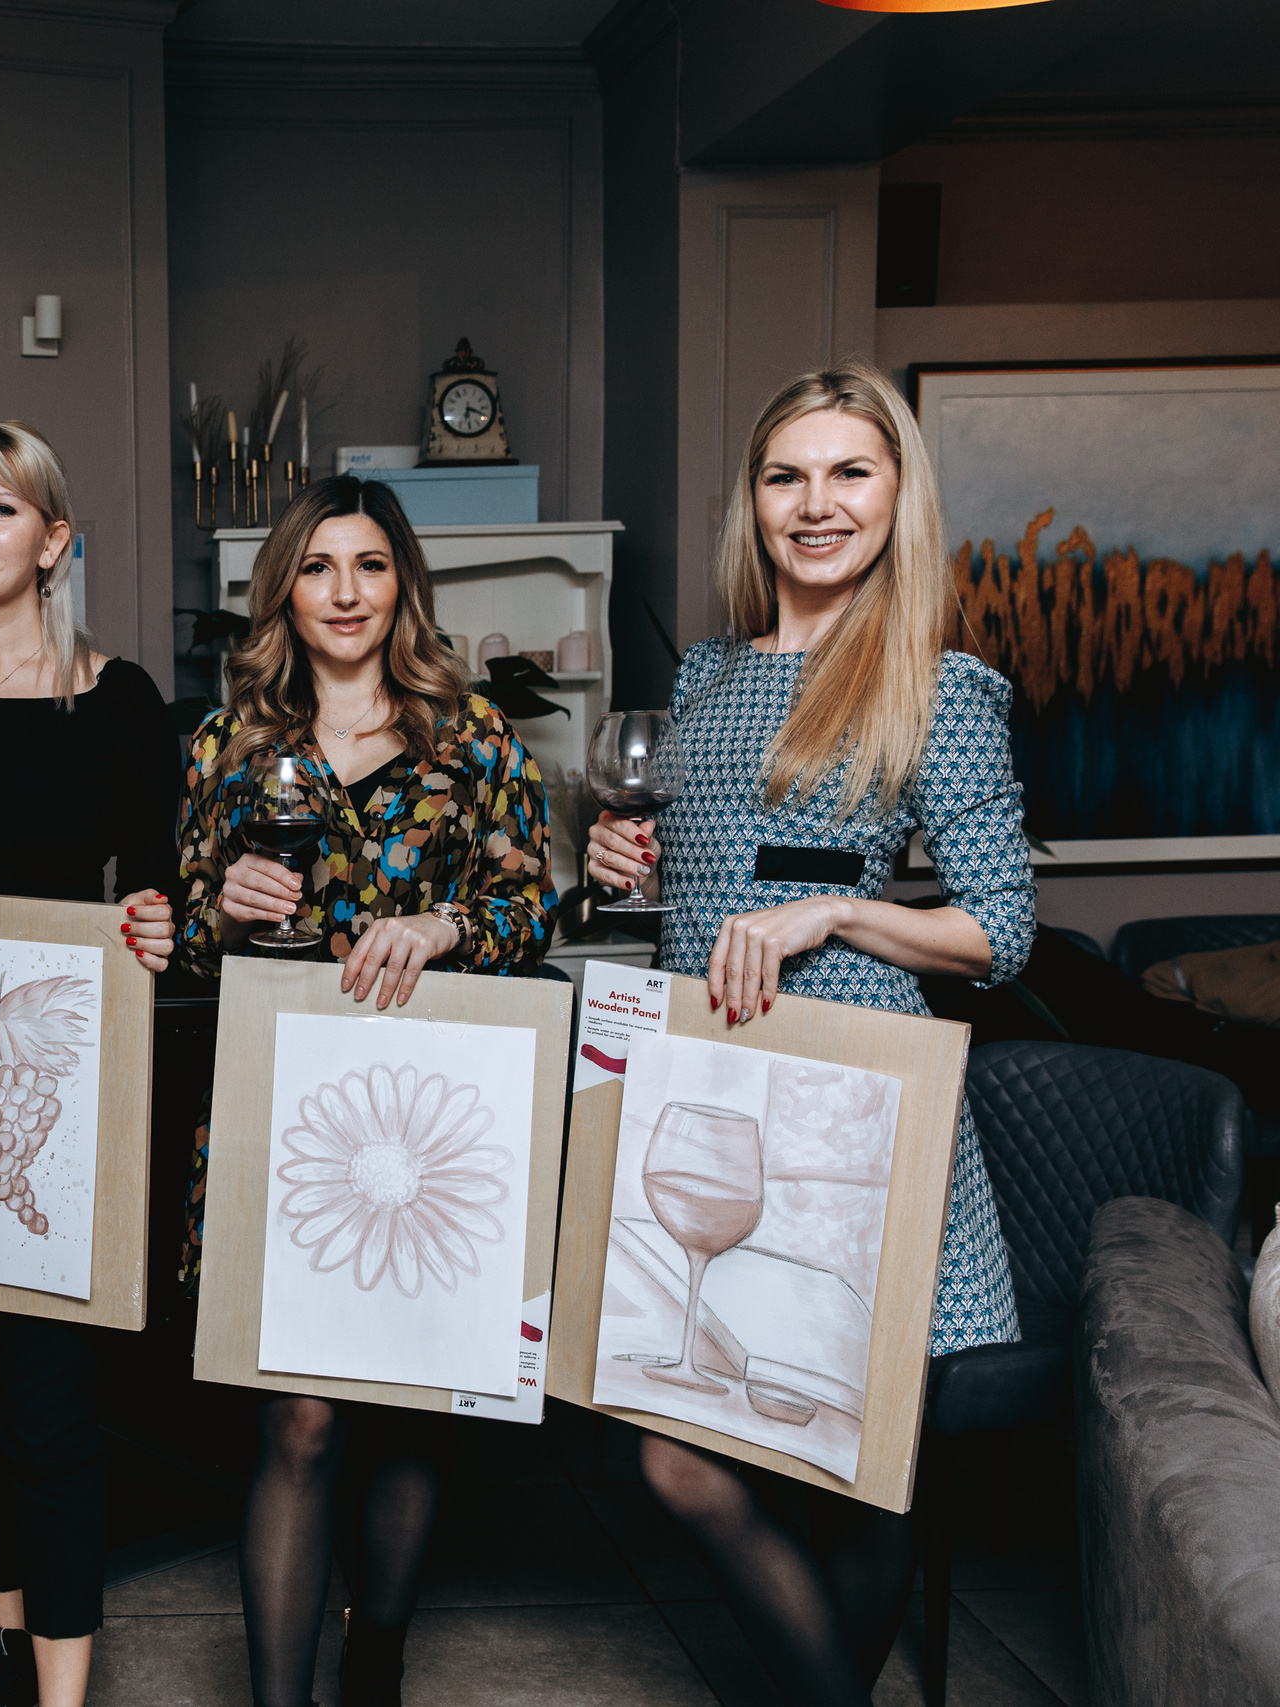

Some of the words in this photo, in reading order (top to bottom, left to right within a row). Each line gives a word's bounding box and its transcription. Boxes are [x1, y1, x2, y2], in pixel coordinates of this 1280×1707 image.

[646, 979, 664, 989] ART
[608, 990, 640, 1004] Artists
[588, 998, 629, 1014] Wooden
[632, 1007, 661, 1020] Panel
[518, 1377, 537, 1387] Wo
[459, 1400, 476, 1408] ART
